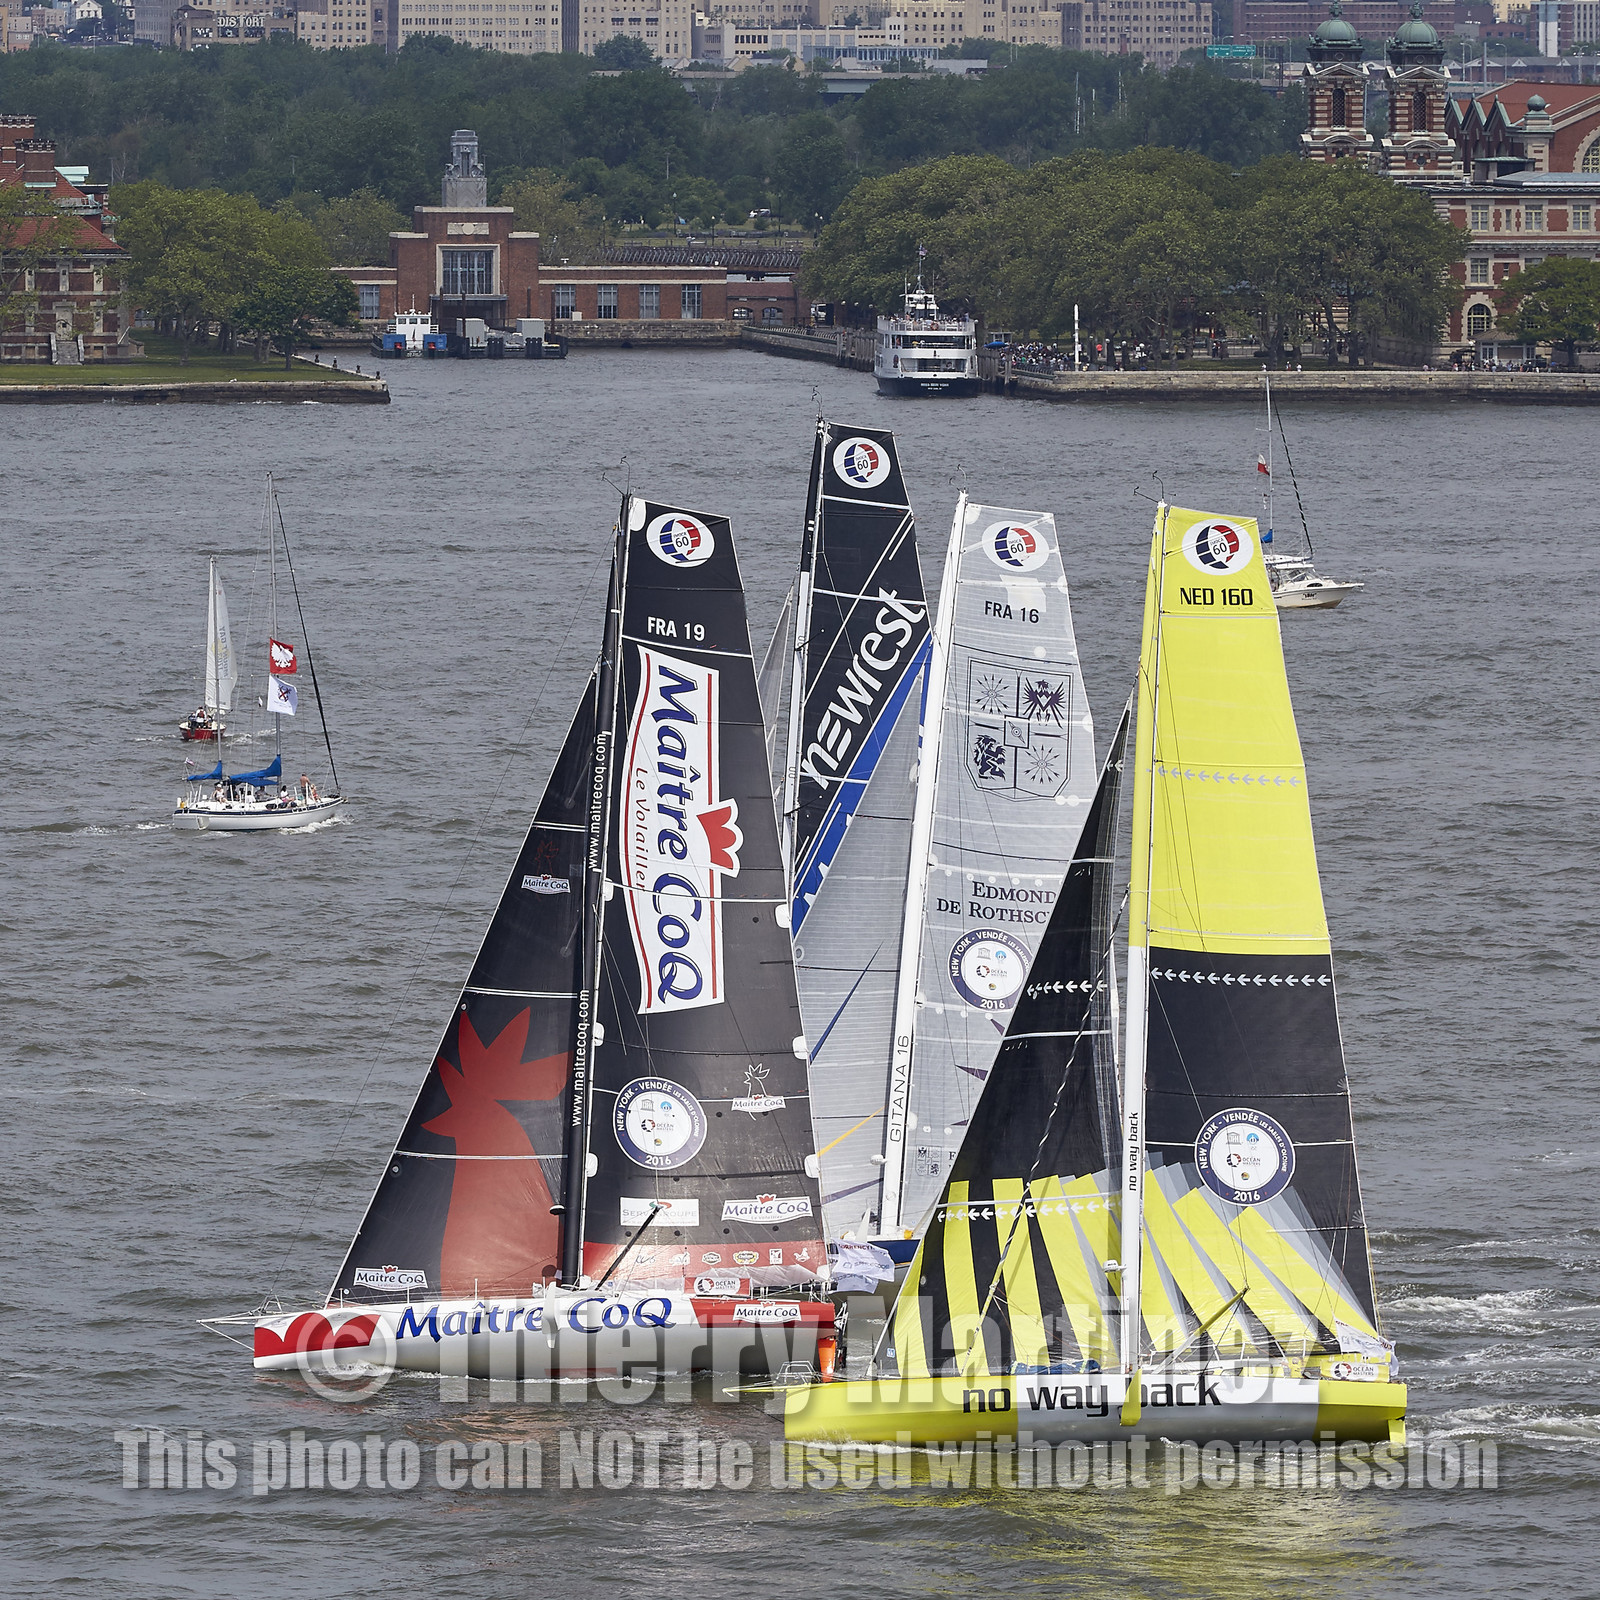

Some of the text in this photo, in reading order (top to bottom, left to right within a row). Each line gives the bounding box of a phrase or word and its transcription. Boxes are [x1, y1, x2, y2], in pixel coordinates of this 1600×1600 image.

[857, 459, 869, 470] 60
[675, 537, 689, 548] 60
[1010, 543, 1024, 554] 60
[1213, 542, 1227, 555] 60
[1180, 587, 1253, 606] NED 160
[984, 600, 1040, 624] FRA 16
[647, 616, 705, 641] FRA 19
[588, 733, 608, 869] www.maitrecoq.com
[635, 767, 650, 892] Le Volailler
[651, 664, 704, 1004] Maître CoQ
[972, 881, 1057, 904] EDMOND
[936, 898, 1050, 924] DE ROTHSC
[954, 937, 971, 956] YORK
[976, 931, 1008, 943] VENDÉE
[952, 958, 960, 977] NEW
[980, 999, 1006, 1010] 2016
[572, 989, 590, 1127] www.maitrecoq.com
[638, 1081, 672, 1092] VENDÉE
[890, 1035, 909, 1142] GITANA 16
[619, 1088, 635, 1108] YORK
[617, 1111, 625, 1131] NEW
[1222, 1112, 1259, 1124] VENDÉE
[1201, 1122, 1218, 1145] YORK
[645, 1154, 672, 1166] 2016
[1128, 1112, 1140, 1191] no way back
[1199, 1148, 1208, 1169] NEW
[1232, 1190, 1261, 1202] 2016
[725, 1201, 809, 1216] Maître CoQ
[356, 1272, 425, 1285] Maître CoQ
[396, 1297, 677, 1343] Maître CoQ
[774, 1307, 798, 1317] CoQ
[963, 1387, 1011, 1413] no
[1026, 1384, 1108, 1417] way
